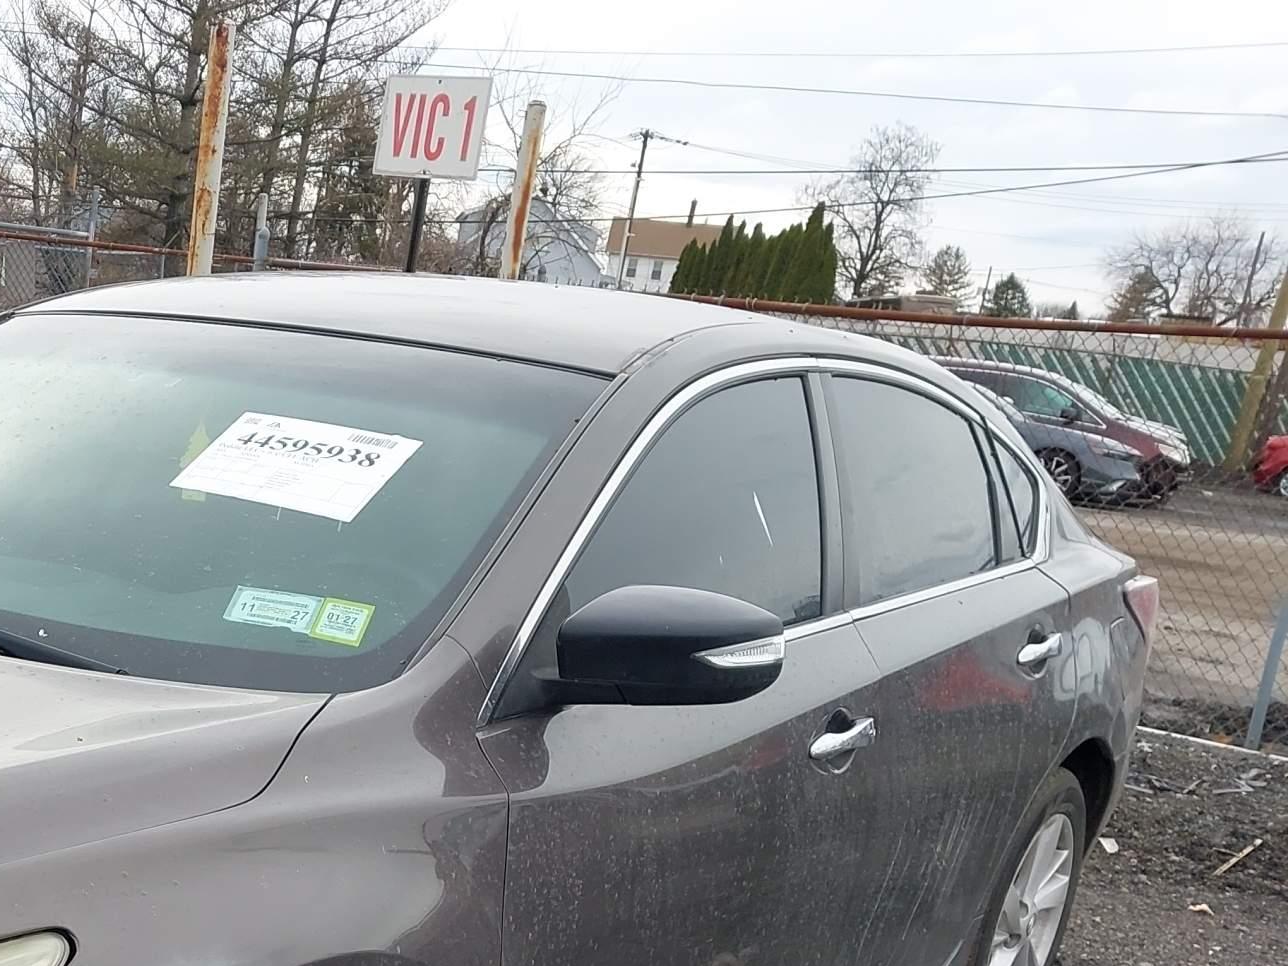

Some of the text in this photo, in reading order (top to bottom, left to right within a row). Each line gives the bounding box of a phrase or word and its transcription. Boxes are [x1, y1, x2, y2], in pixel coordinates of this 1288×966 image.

[392, 92, 478, 162] VIC 1
[237, 431, 381, 468] 44595938
[240, 601, 256, 613] 11
[290, 610, 310, 621] 27
